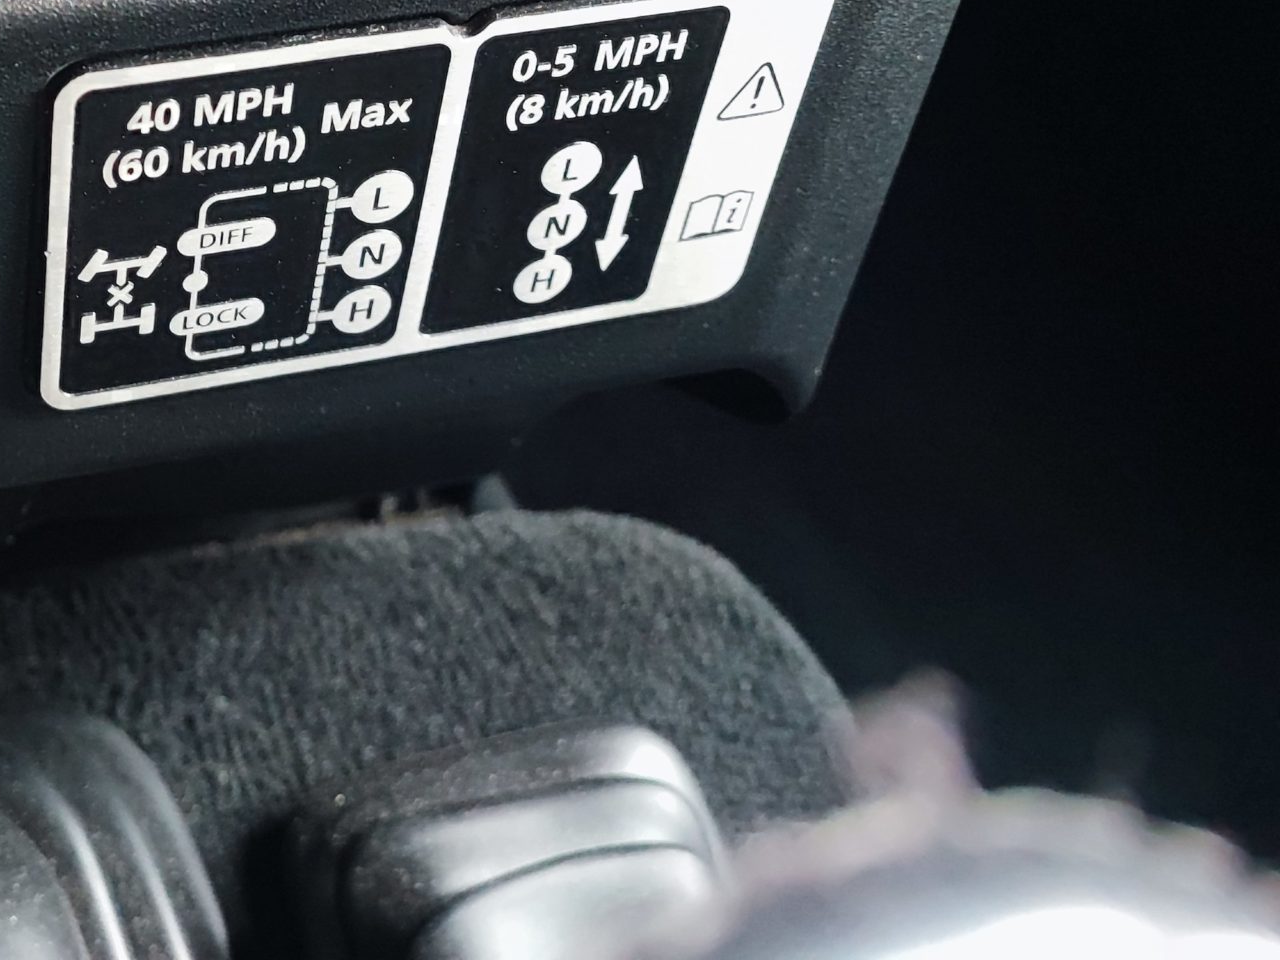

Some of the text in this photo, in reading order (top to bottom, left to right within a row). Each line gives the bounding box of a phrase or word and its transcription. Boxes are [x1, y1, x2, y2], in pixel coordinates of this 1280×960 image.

[512, 29, 688, 83] 0-5 MPH
[126, 82, 294, 134] 40 MPH
[320, 98, 412, 134] Max
[505, 74, 670, 132] (8 km/h)
[102, 126, 306, 189] (60 km/h)
[562, 158, 578, 182] L
[372, 187, 390, 211] L
[199, 226, 255, 250] DIFF
[544, 214, 571, 239] N
[358, 243, 386, 269] N
[530, 269, 556, 293] H
[181, 305, 249, 331] LOCK
[348, 298, 375, 323] H
